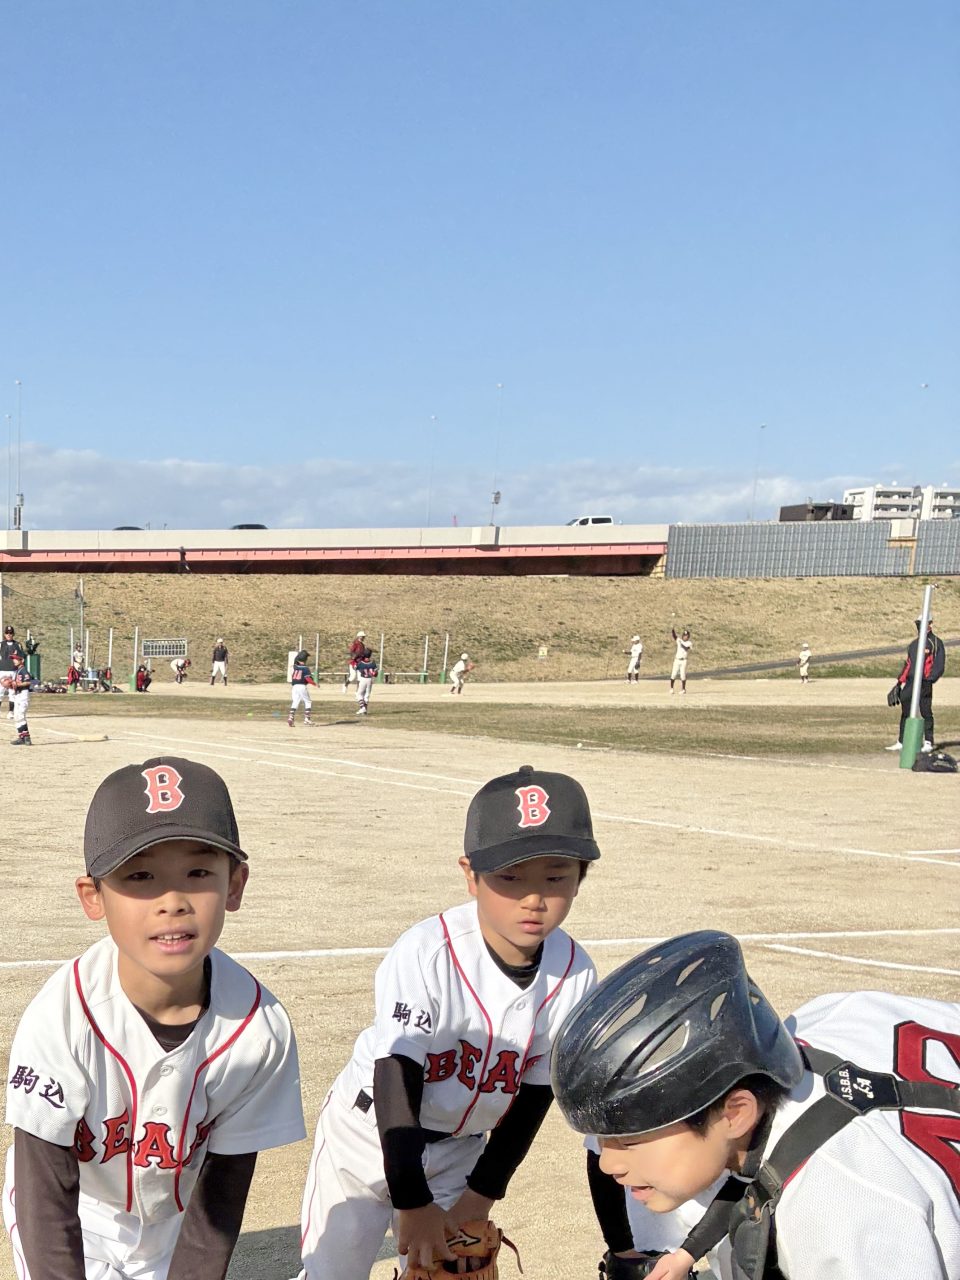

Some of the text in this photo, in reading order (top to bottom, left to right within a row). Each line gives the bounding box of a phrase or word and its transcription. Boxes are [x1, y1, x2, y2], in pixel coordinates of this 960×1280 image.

[141, 765, 185, 814] B
[515, 784, 551, 828] B
[392, 1001, 432, 1034] 駒込
[9, 1065, 66, 1109] 駒込
[839, 1068, 854, 1102] J.S.B.B.
